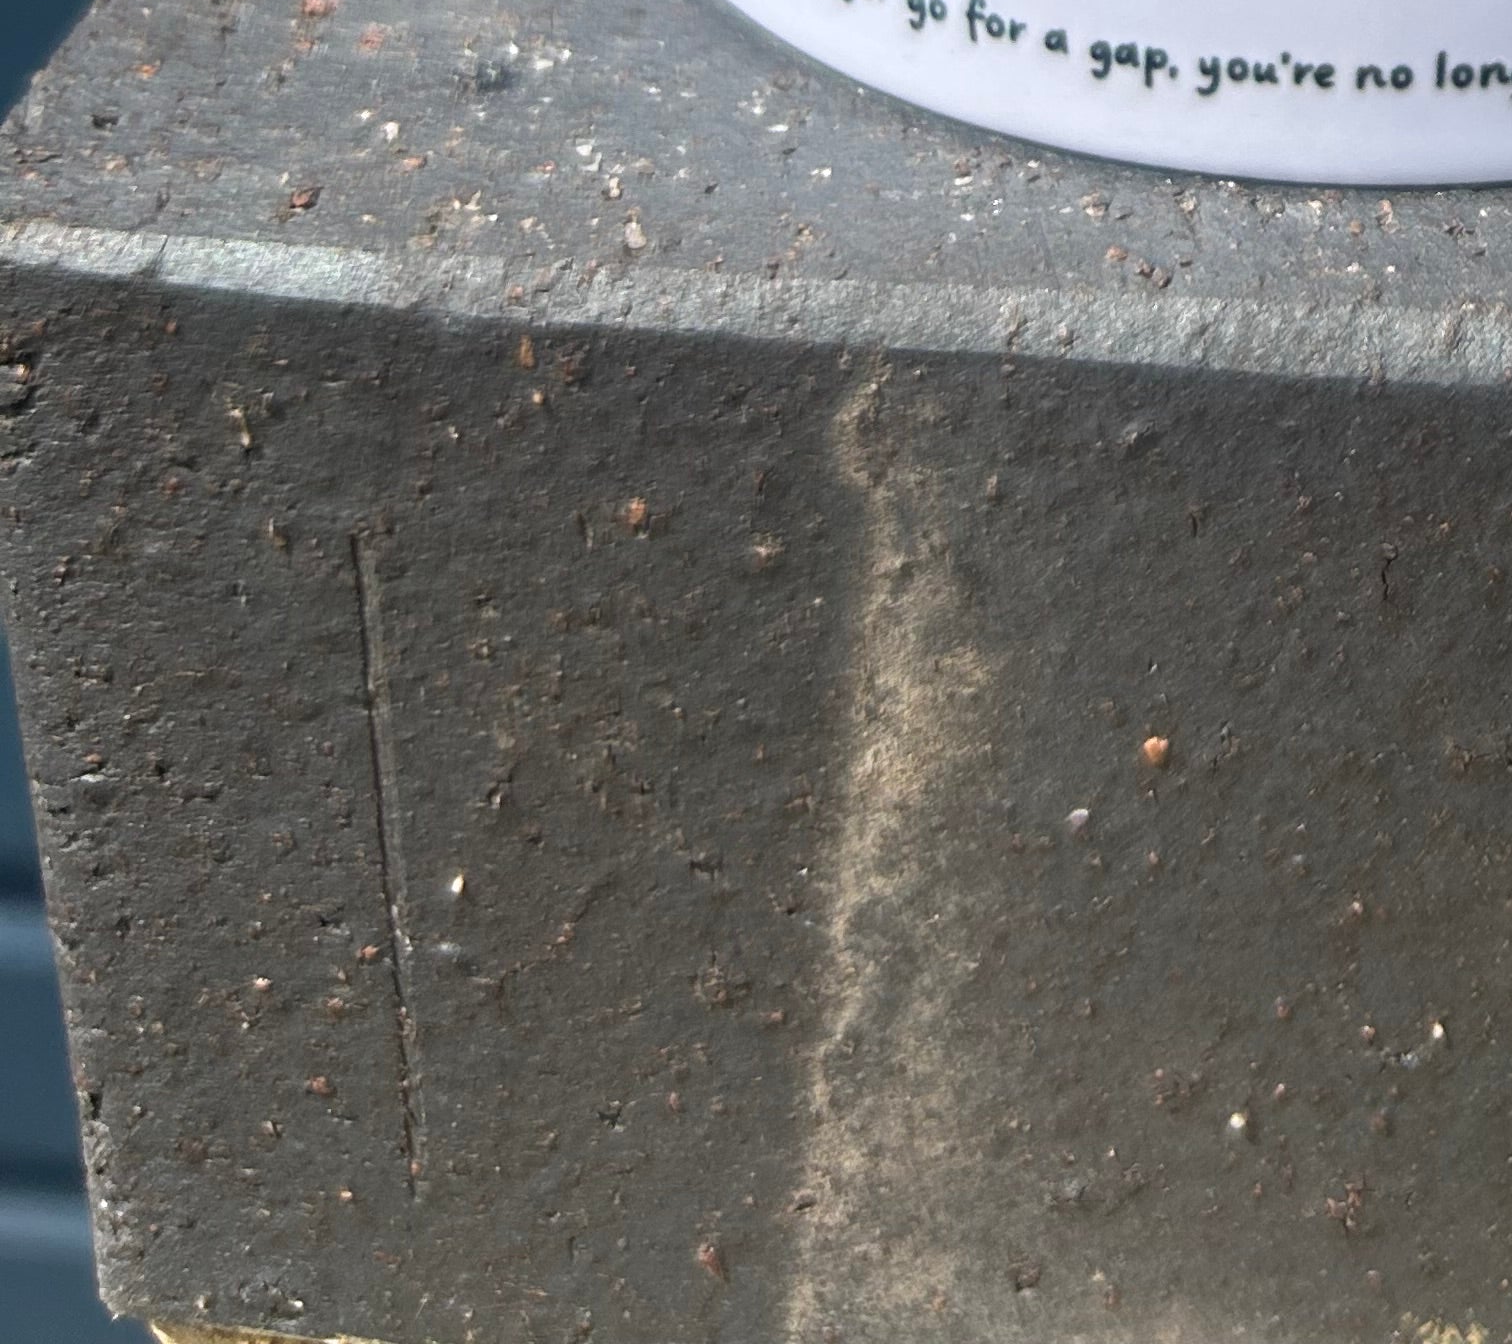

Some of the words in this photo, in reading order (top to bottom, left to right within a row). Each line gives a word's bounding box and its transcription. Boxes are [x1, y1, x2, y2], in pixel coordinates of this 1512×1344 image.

[1041, 27, 1071, 58] a
[1194, 49, 1337, 98] you're
[1353, 62, 1416, 94] no
